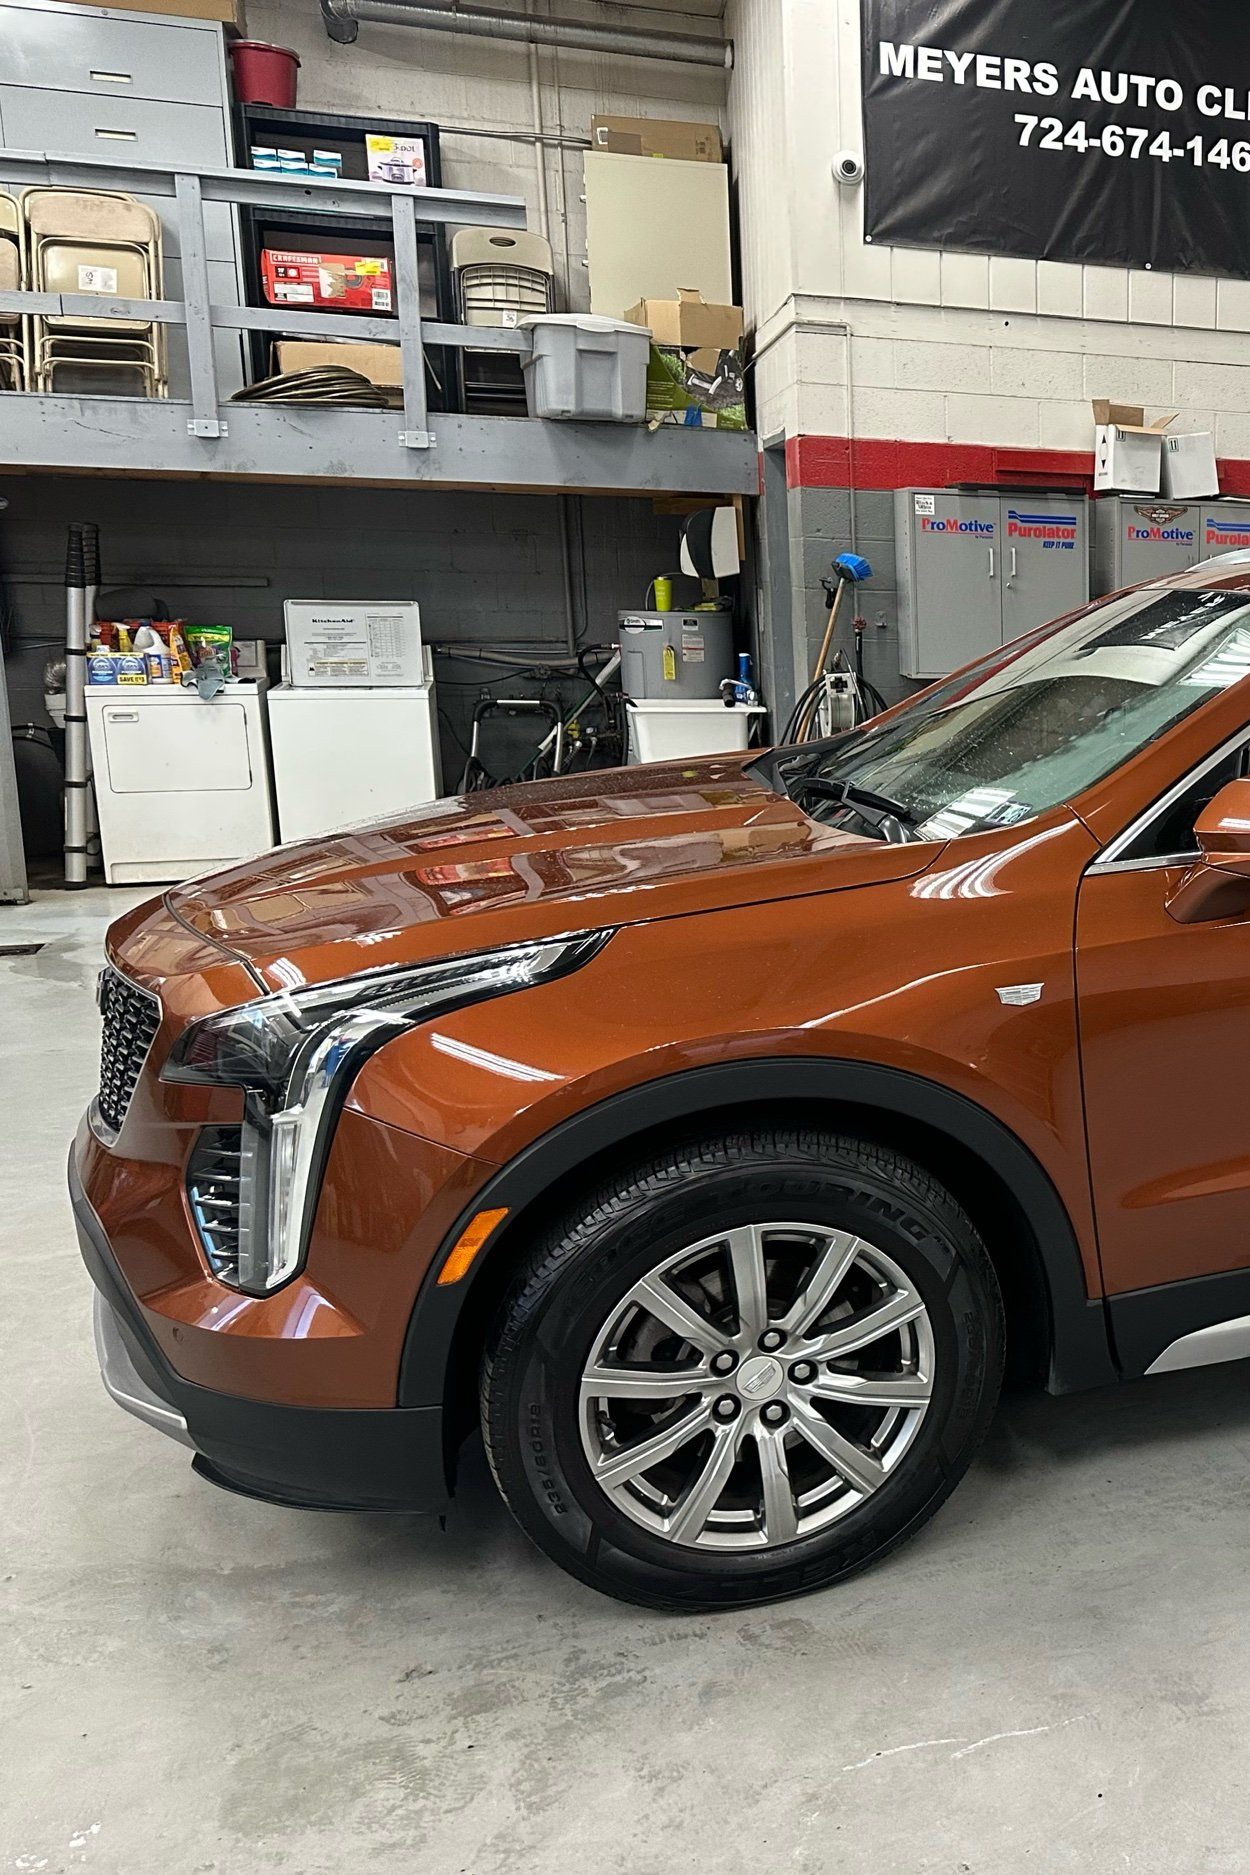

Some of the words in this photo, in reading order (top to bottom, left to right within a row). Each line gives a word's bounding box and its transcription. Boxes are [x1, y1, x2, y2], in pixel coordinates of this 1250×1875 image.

[879, 41, 1059, 96] MEYERS
[1071, 68, 1184, 112] AUTO
[272, 254, 319, 263] CRAFTSMAN
[921, 517, 994, 534] ProMotive
[1008, 522, 1076, 539] Purolator
[1127, 525, 1194, 541] ProMotive
[1061, 541, 1075, 549] PURE
